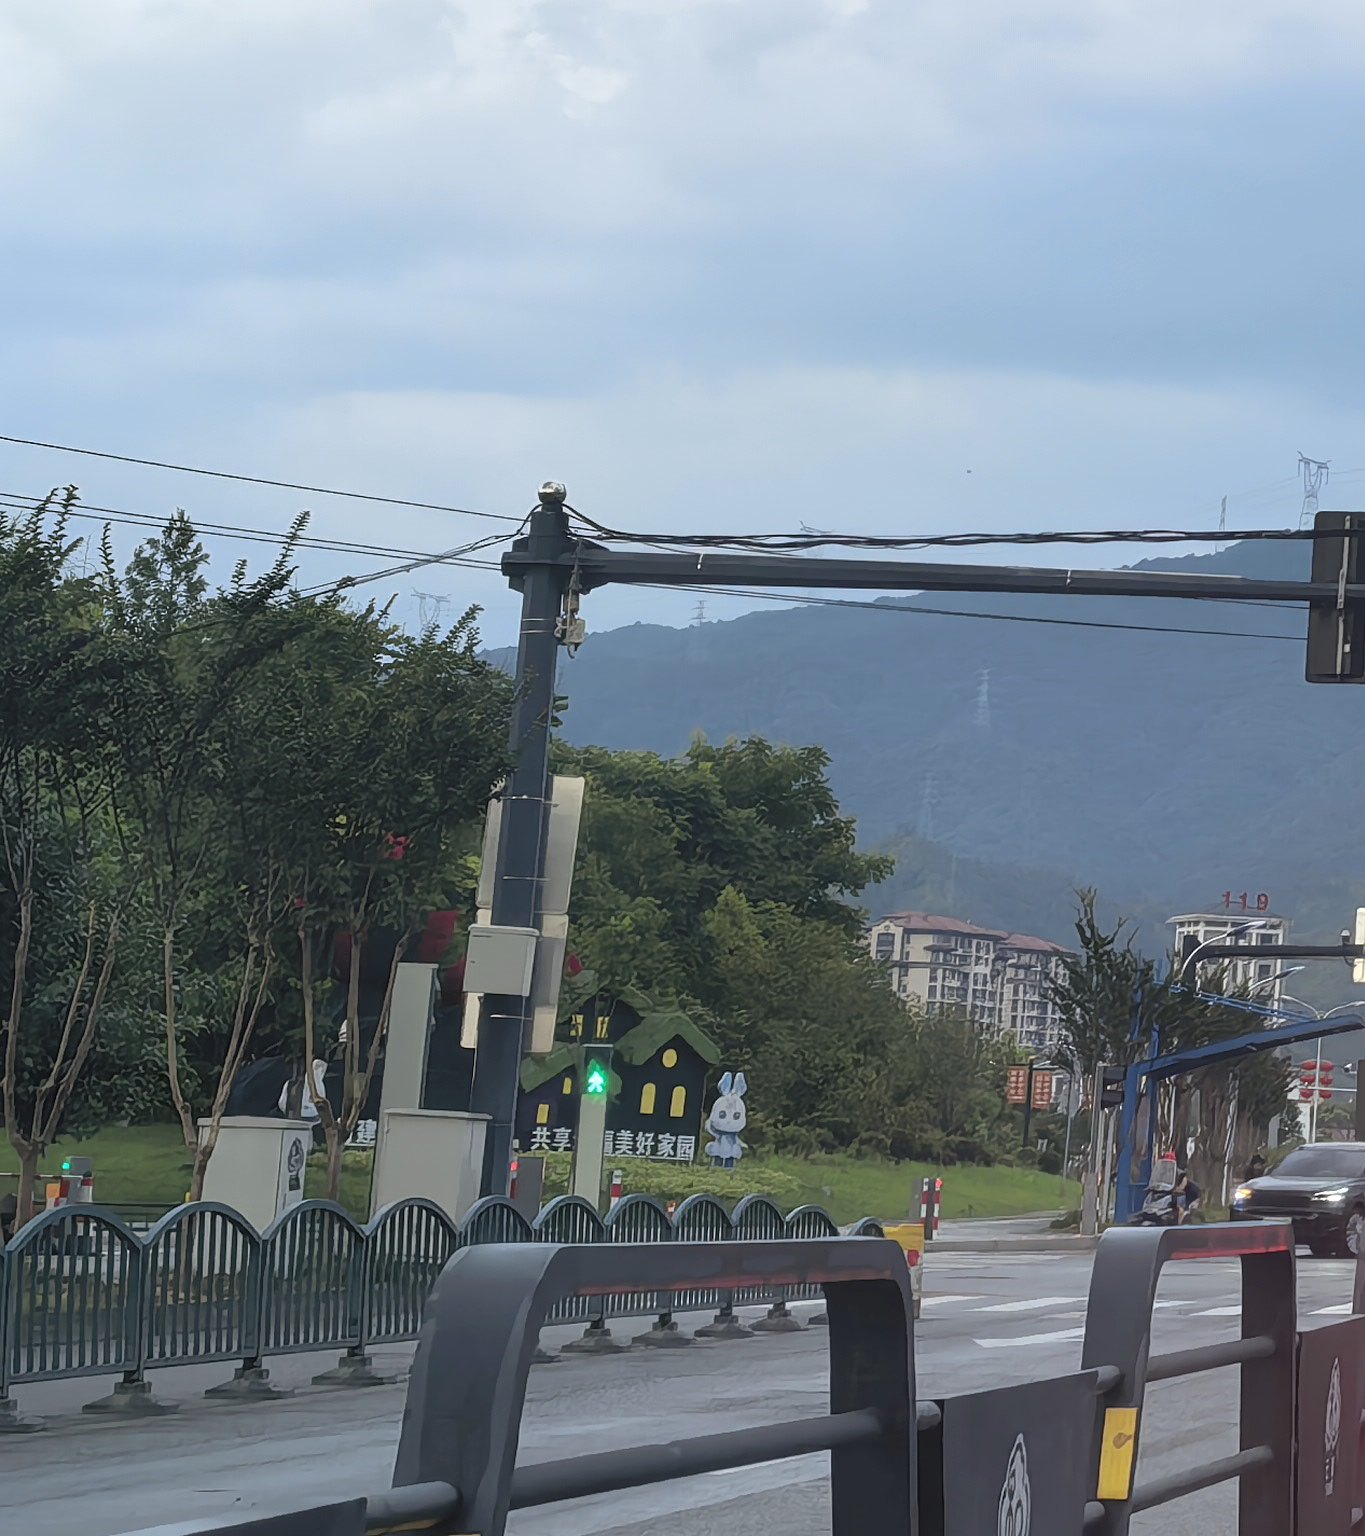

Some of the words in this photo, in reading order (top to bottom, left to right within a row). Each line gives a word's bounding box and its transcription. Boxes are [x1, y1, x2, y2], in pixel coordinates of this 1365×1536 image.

[531, 1127, 696, 1161] 共享美好家园
